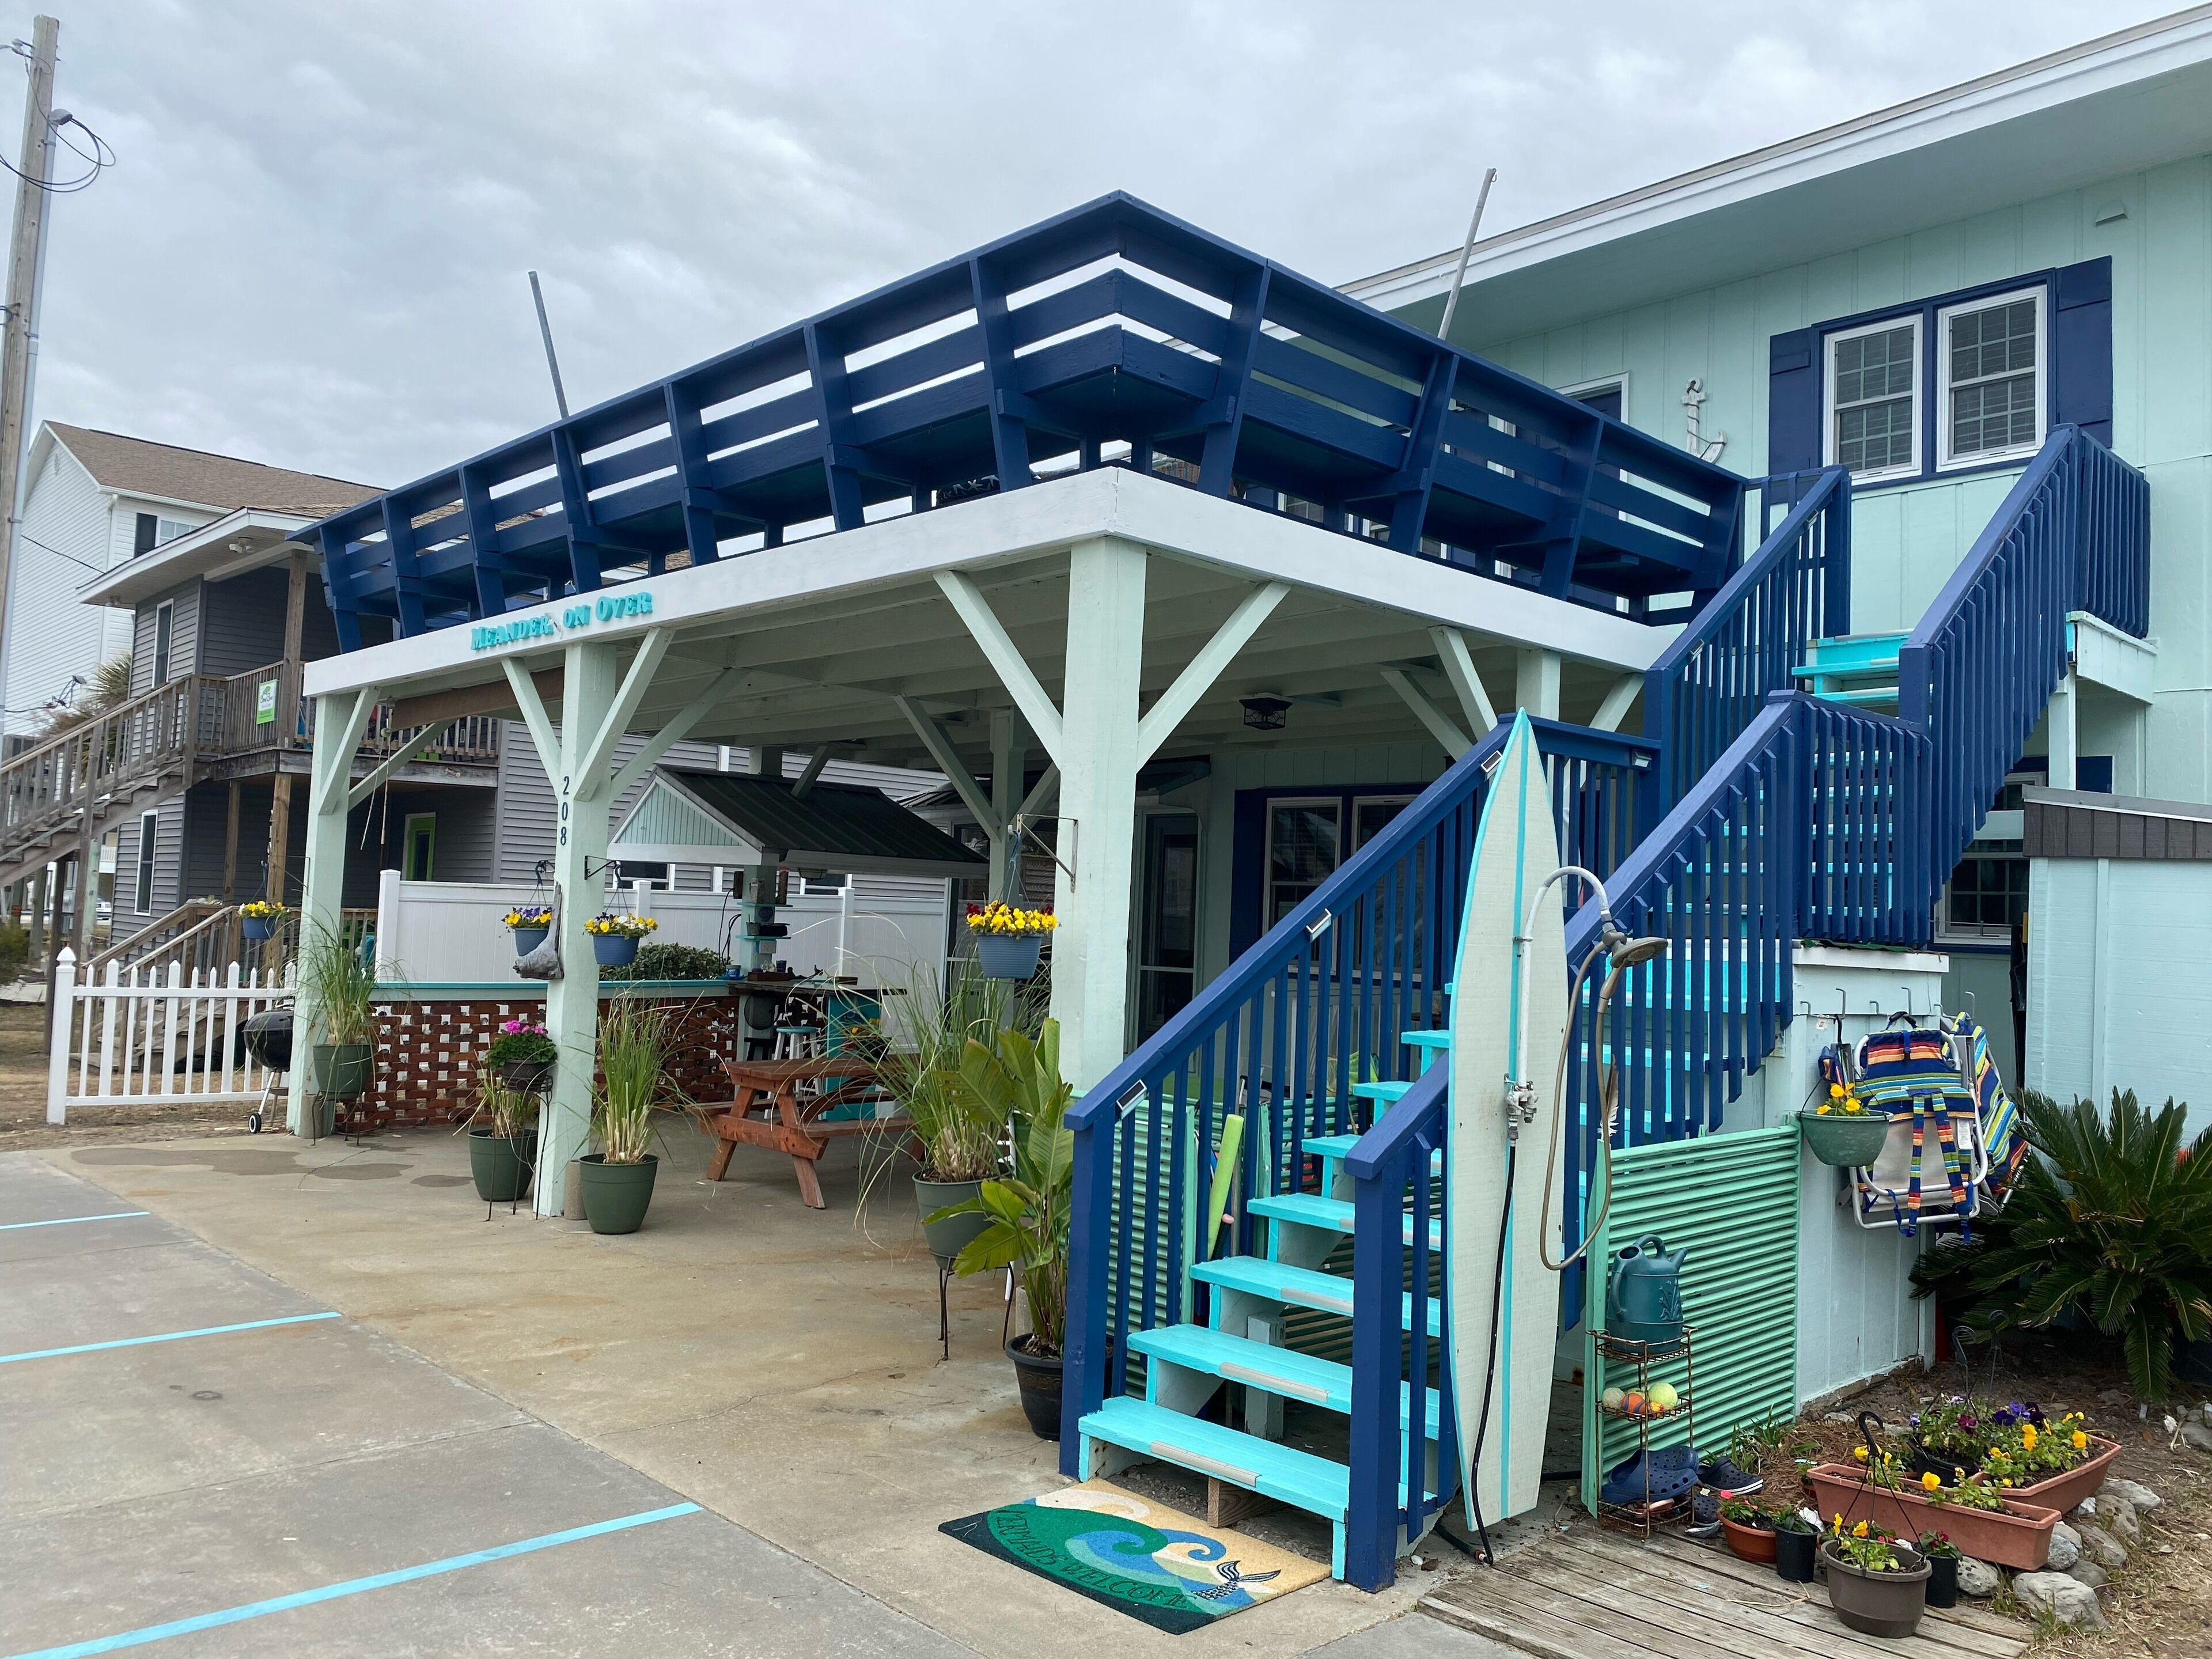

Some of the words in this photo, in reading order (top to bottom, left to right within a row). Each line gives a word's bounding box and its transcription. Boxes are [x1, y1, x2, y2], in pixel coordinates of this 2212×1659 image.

[471, 615, 554, 650] MEANDER
[563, 605, 591, 628] ON
[596, 593, 653, 622] OVER
[560, 775, 570, 846] 208
[995, 1509, 1069, 1566] MERMAIDS
[1059, 1562, 1198, 1609] WELCOME
